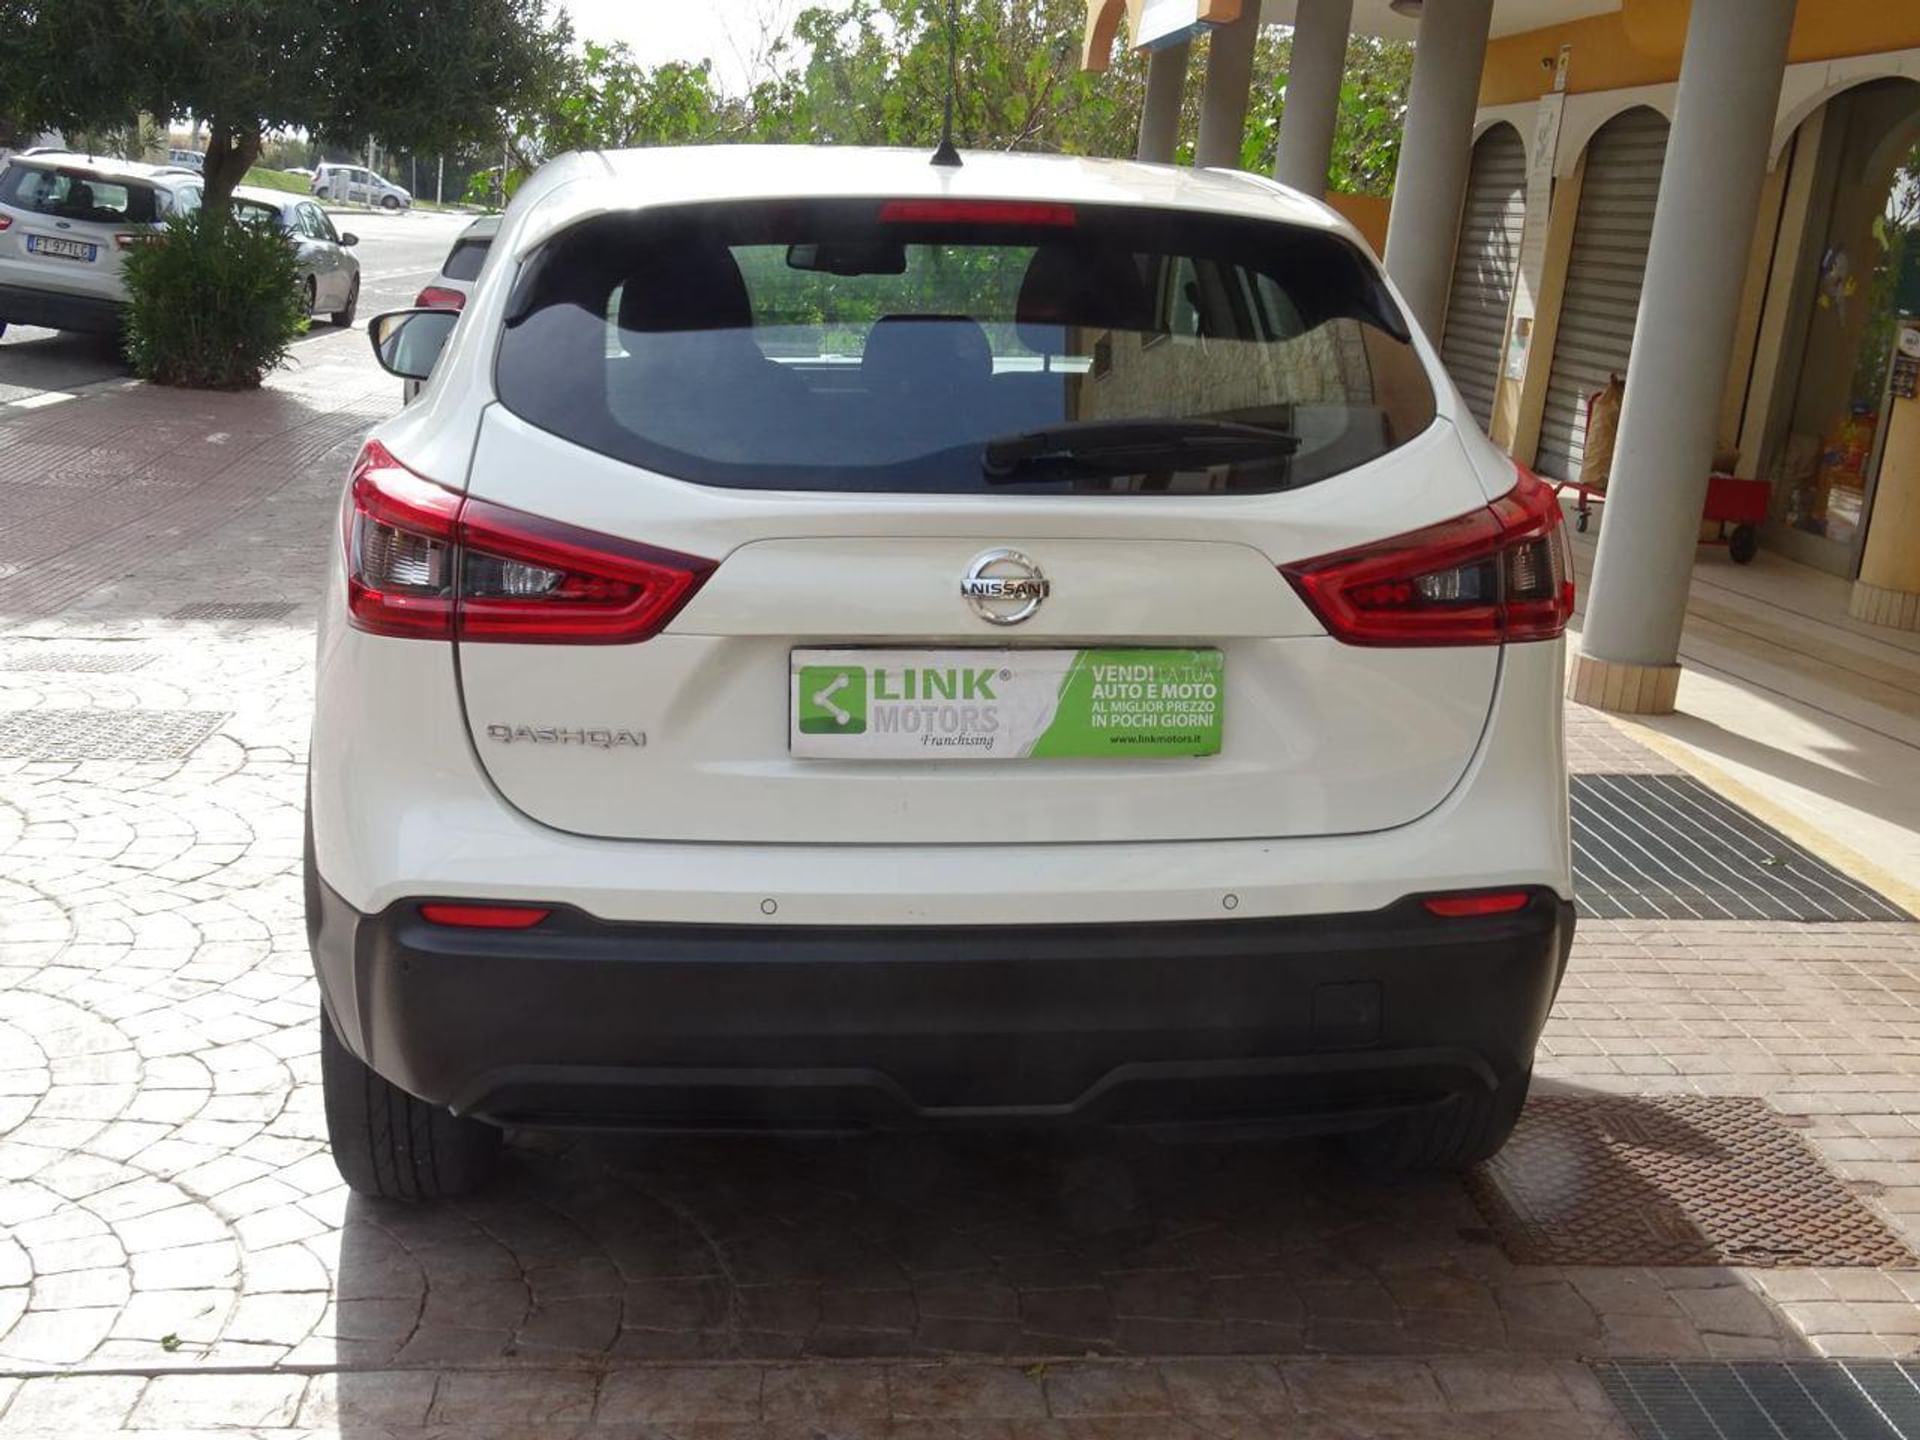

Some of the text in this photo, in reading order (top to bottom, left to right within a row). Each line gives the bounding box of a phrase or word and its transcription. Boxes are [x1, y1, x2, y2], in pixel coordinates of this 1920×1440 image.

[970, 583, 1041, 595] NISSAN
[1091, 665, 1154, 682] VENDI
[1181, 666, 1214, 682] TUA
[1091, 684, 1217, 699] AUTO E MOTO
[1091, 700, 1216, 714] AL MIGLIOR PREZZO
[874, 705, 1000, 733] MOTORS
[1091, 714, 1214, 728] IN POCHI GIORNI
[487, 723, 648, 750] QASHQAI
[920, 730, 995, 750] Franchising
[1109, 734, 1201, 744] www.linkmotors.it
